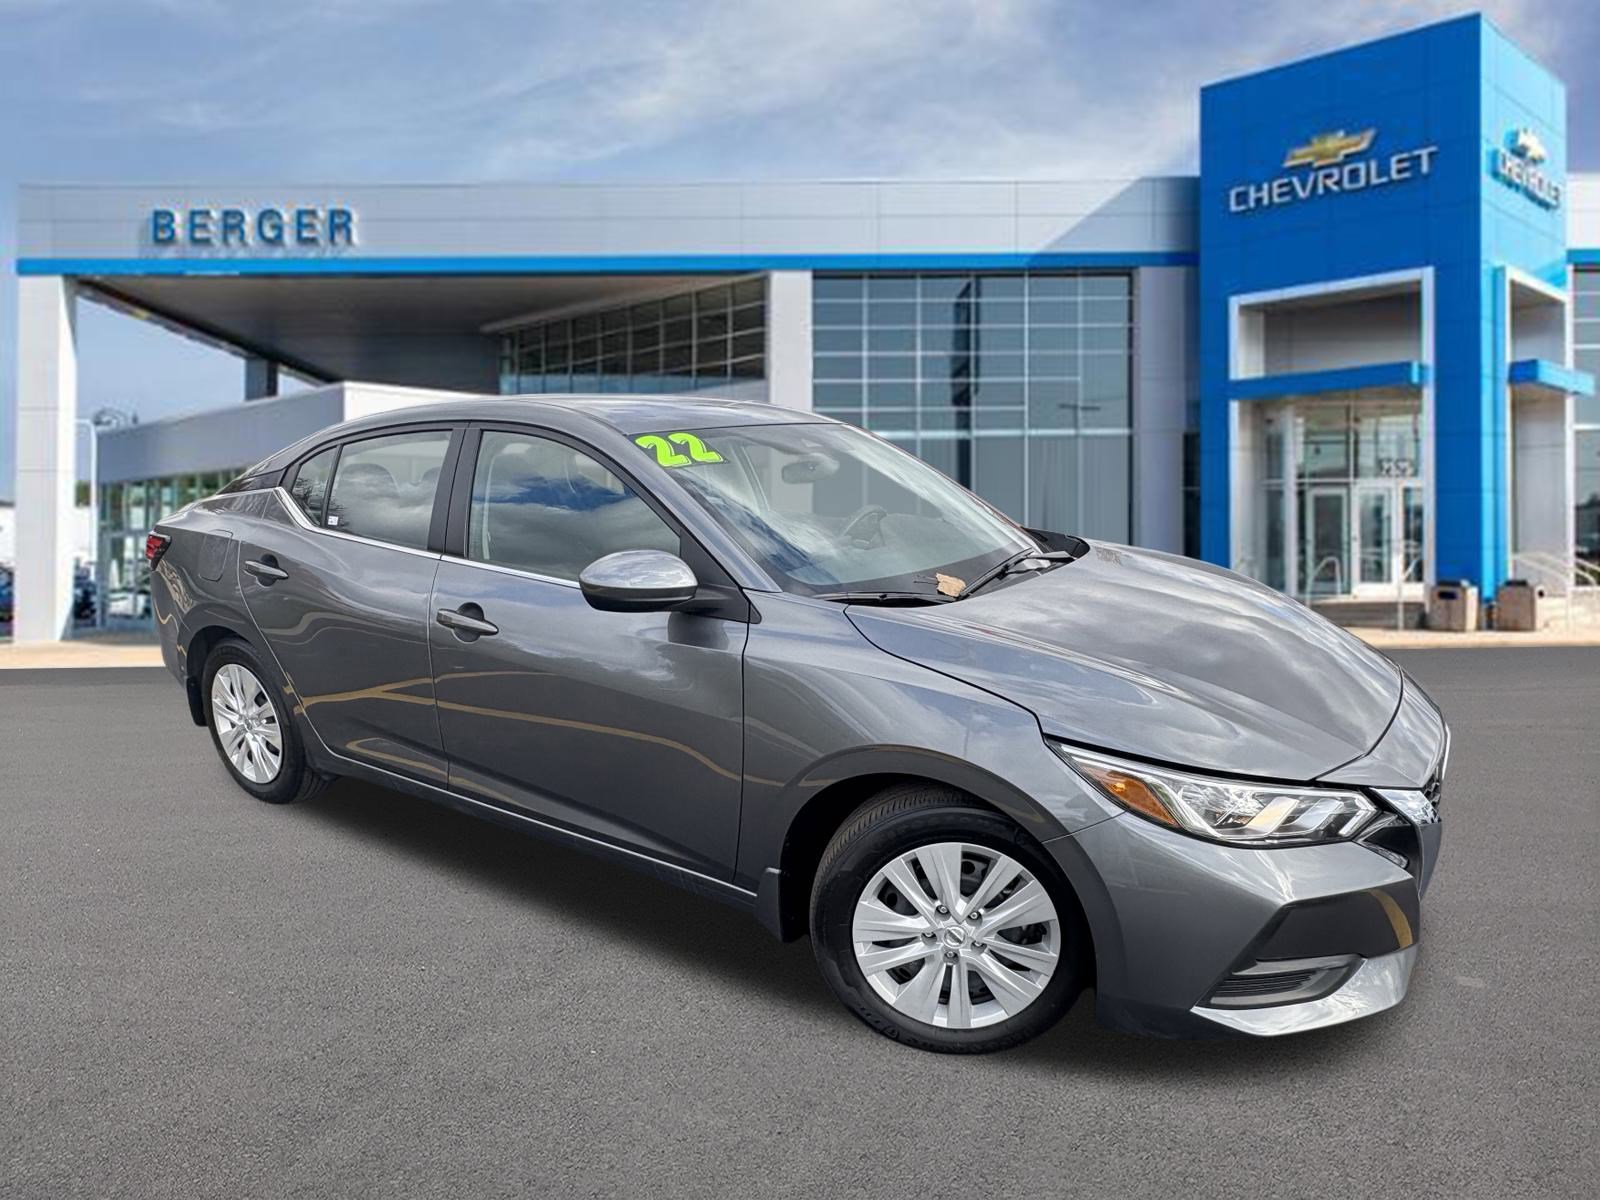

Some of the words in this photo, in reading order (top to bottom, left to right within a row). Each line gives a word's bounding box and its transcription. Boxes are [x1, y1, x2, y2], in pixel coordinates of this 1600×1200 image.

[1229, 146, 1438, 212] CHEVROLET
[152, 208, 355, 244] BERGER
[635, 432, 724, 467] 22
